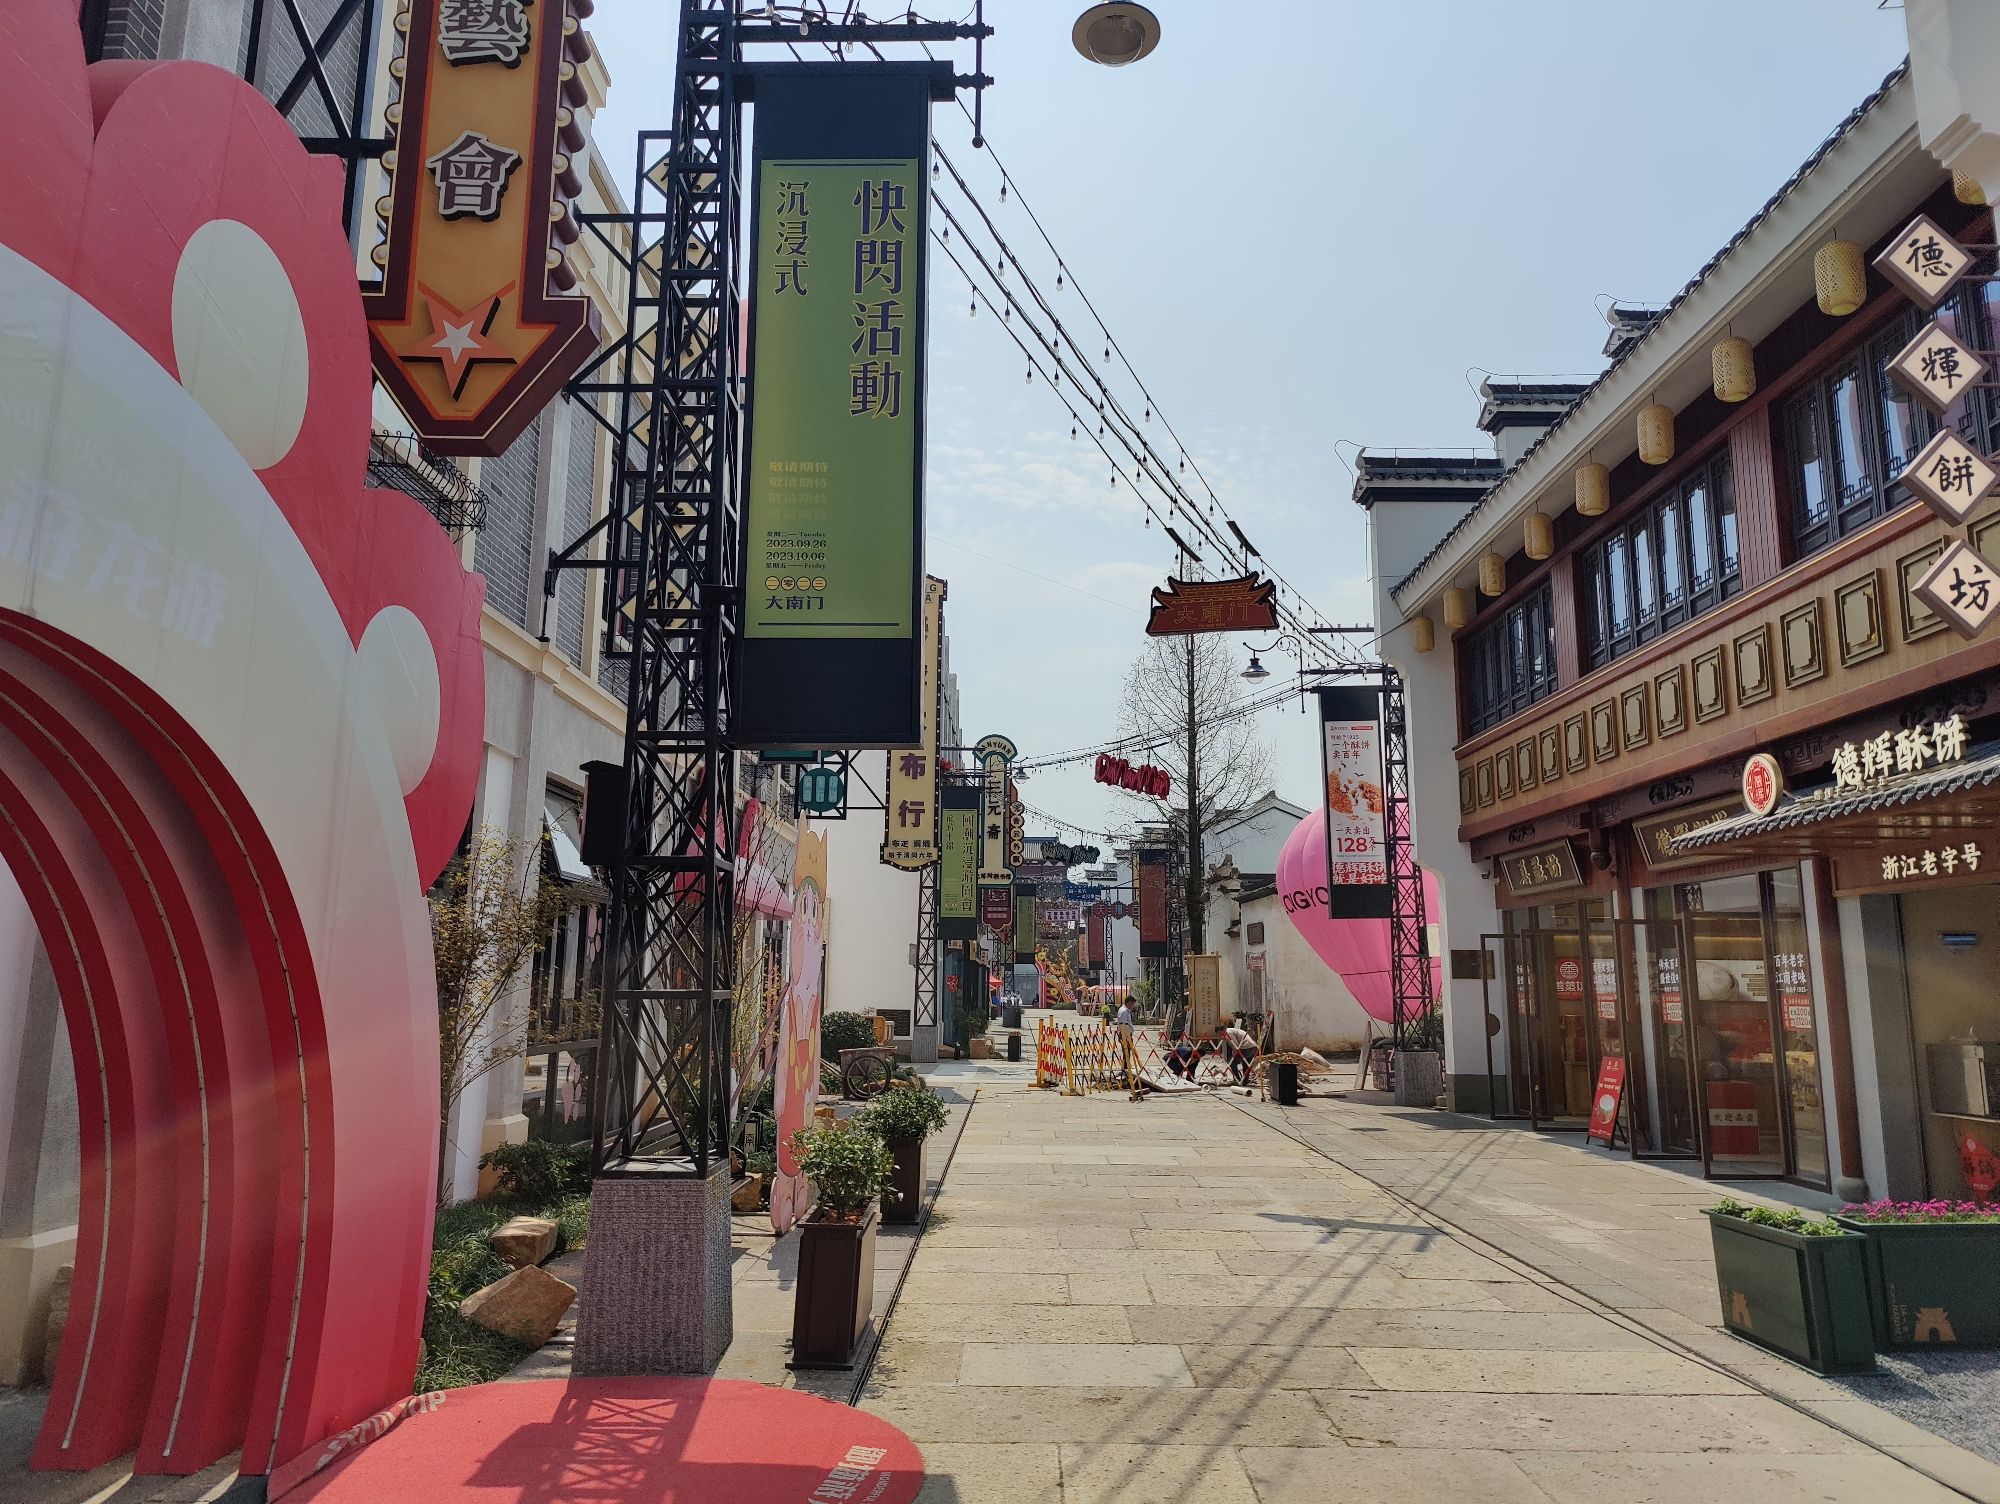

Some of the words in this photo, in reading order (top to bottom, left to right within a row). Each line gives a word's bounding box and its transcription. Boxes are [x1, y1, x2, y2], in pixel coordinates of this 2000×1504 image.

[774, 180, 809, 296] 沉浸式
[850, 179, 907, 420] 快閃活動
[1904, 235, 1991, 613] 德輝餅坊
[768, 461, 828, 472] 敬请期待
[766, 539, 827, 548] 2023.09.26
[765, 552, 825, 561] 2023.10.06
[765, 595, 824, 610] 大南门
[1173, 602, 1249, 626] 大南门
[1331, 740, 1370, 750] 一个酥饼
[1831, 713, 1968, 788] 德辉酥饼
[1332, 750, 1360, 760] 卖百年
[1335, 826, 1370, 835] 一天卖出
[1336, 837, 1368, 853] 128
[1881, 842, 1982, 881] 浙江老字号
